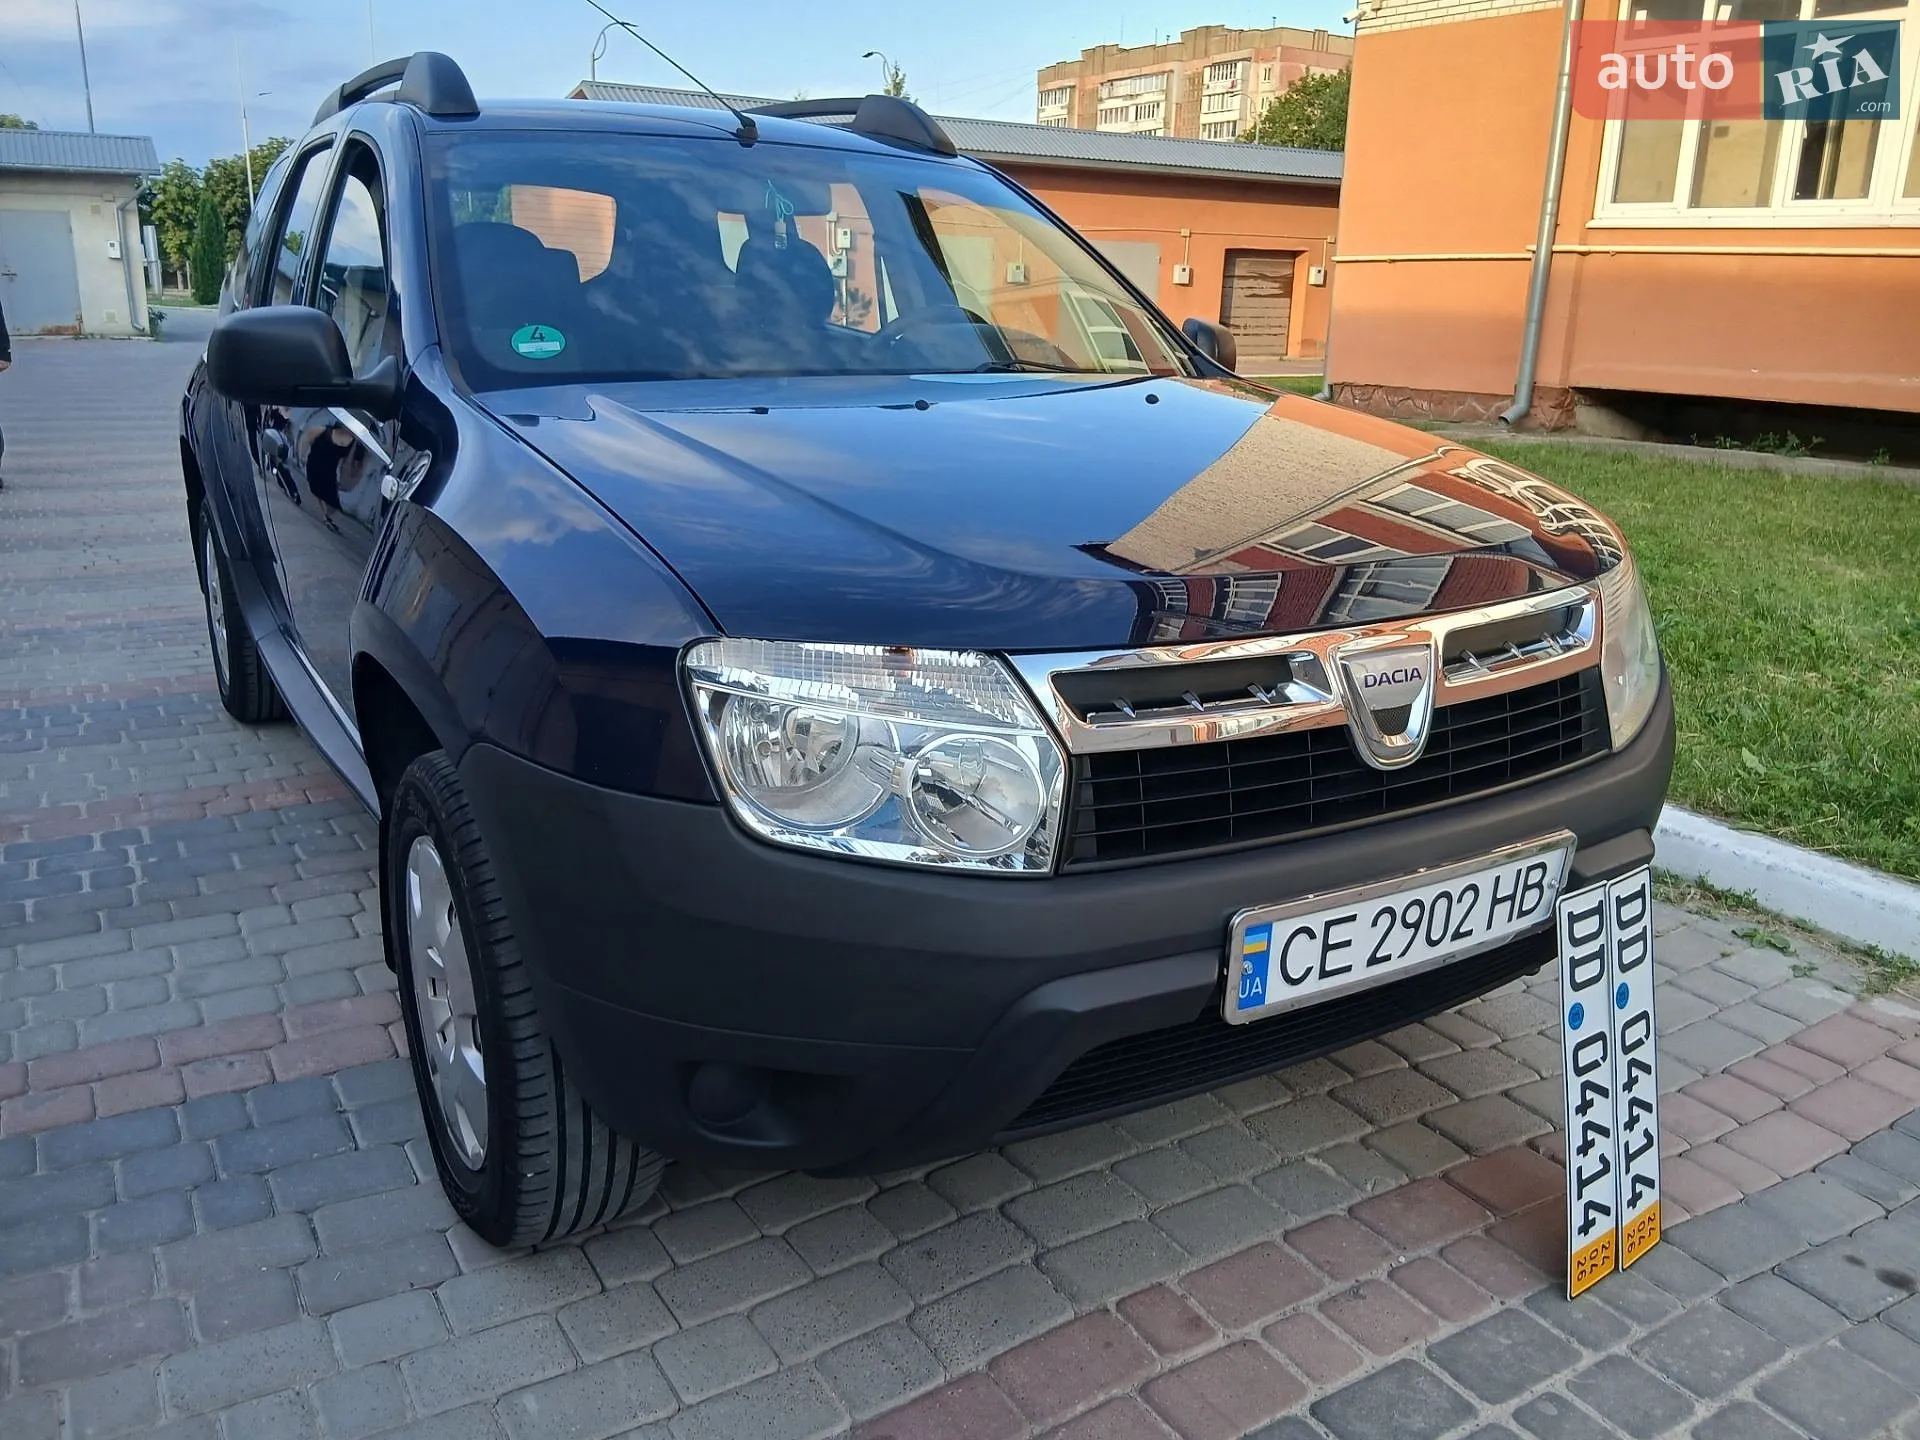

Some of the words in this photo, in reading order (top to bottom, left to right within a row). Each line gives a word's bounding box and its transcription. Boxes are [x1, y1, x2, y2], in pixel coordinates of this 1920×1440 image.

[531, 326, 545, 342] 4
[1364, 667, 1422, 689] DACIA
[1280, 913, 1357, 986] CE
[1366, 883, 1480, 968] 2902
[1486, 861, 1548, 931] HB
[1567, 899, 1605, 992] DD
[1615, 882, 1648, 973] DD
[1239, 976, 1263, 998] UA
[1572, 1031, 1611, 1237] 04414
[1621, 1010, 1656, 1210] 04414
